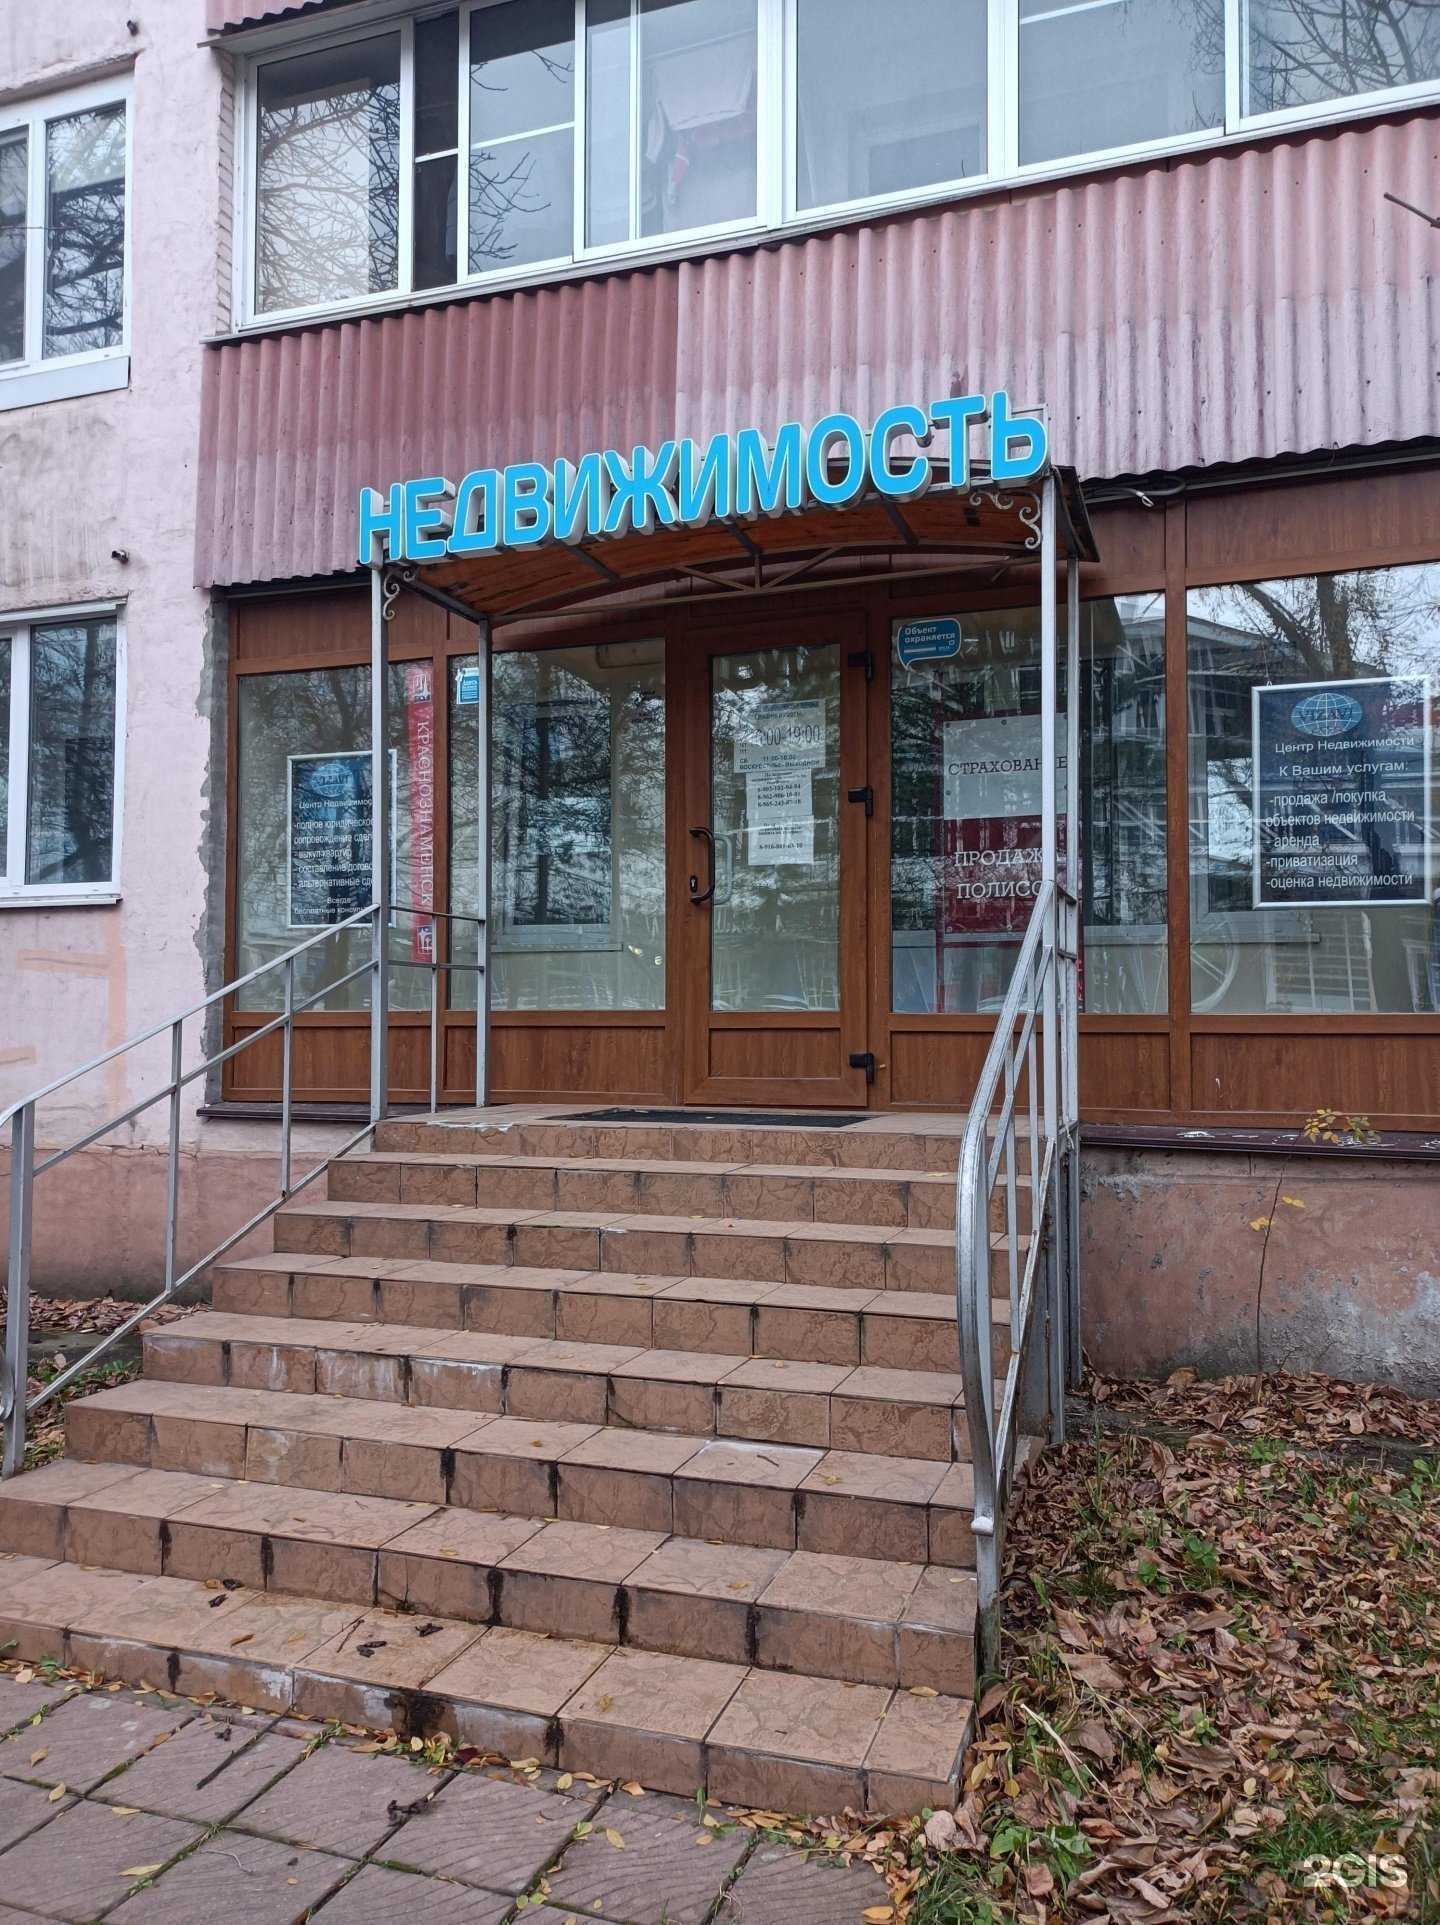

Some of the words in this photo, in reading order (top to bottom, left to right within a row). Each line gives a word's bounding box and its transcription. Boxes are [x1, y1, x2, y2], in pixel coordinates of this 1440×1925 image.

[359, 391, 1048, 565] НЕДВИЖИМОСТЬ
[1275, 742, 1314, 754] Центр
[1318, 737, 1415, 750] Недвижимости
[948, 757, 1067, 776] СТРАХОВАНЕ
[1279, 765, 1288, 777] К
[1292, 765, 1342, 776] Вашим
[1347, 761, 1409, 776] услугам:
[417, 721, 434, 905] КРАСНОЗНАМЕНСК
[1265, 813, 1321, 827] объектов
[1324, 809, 1415, 826] недвижимости
[1273, 834, 1320, 848] аренда
[954, 847, 1061, 868] ПРОДАЖ
[1318, 872, 1413, 889] недвижимости
[956, 881, 1042, 899] ПОЛИСО
